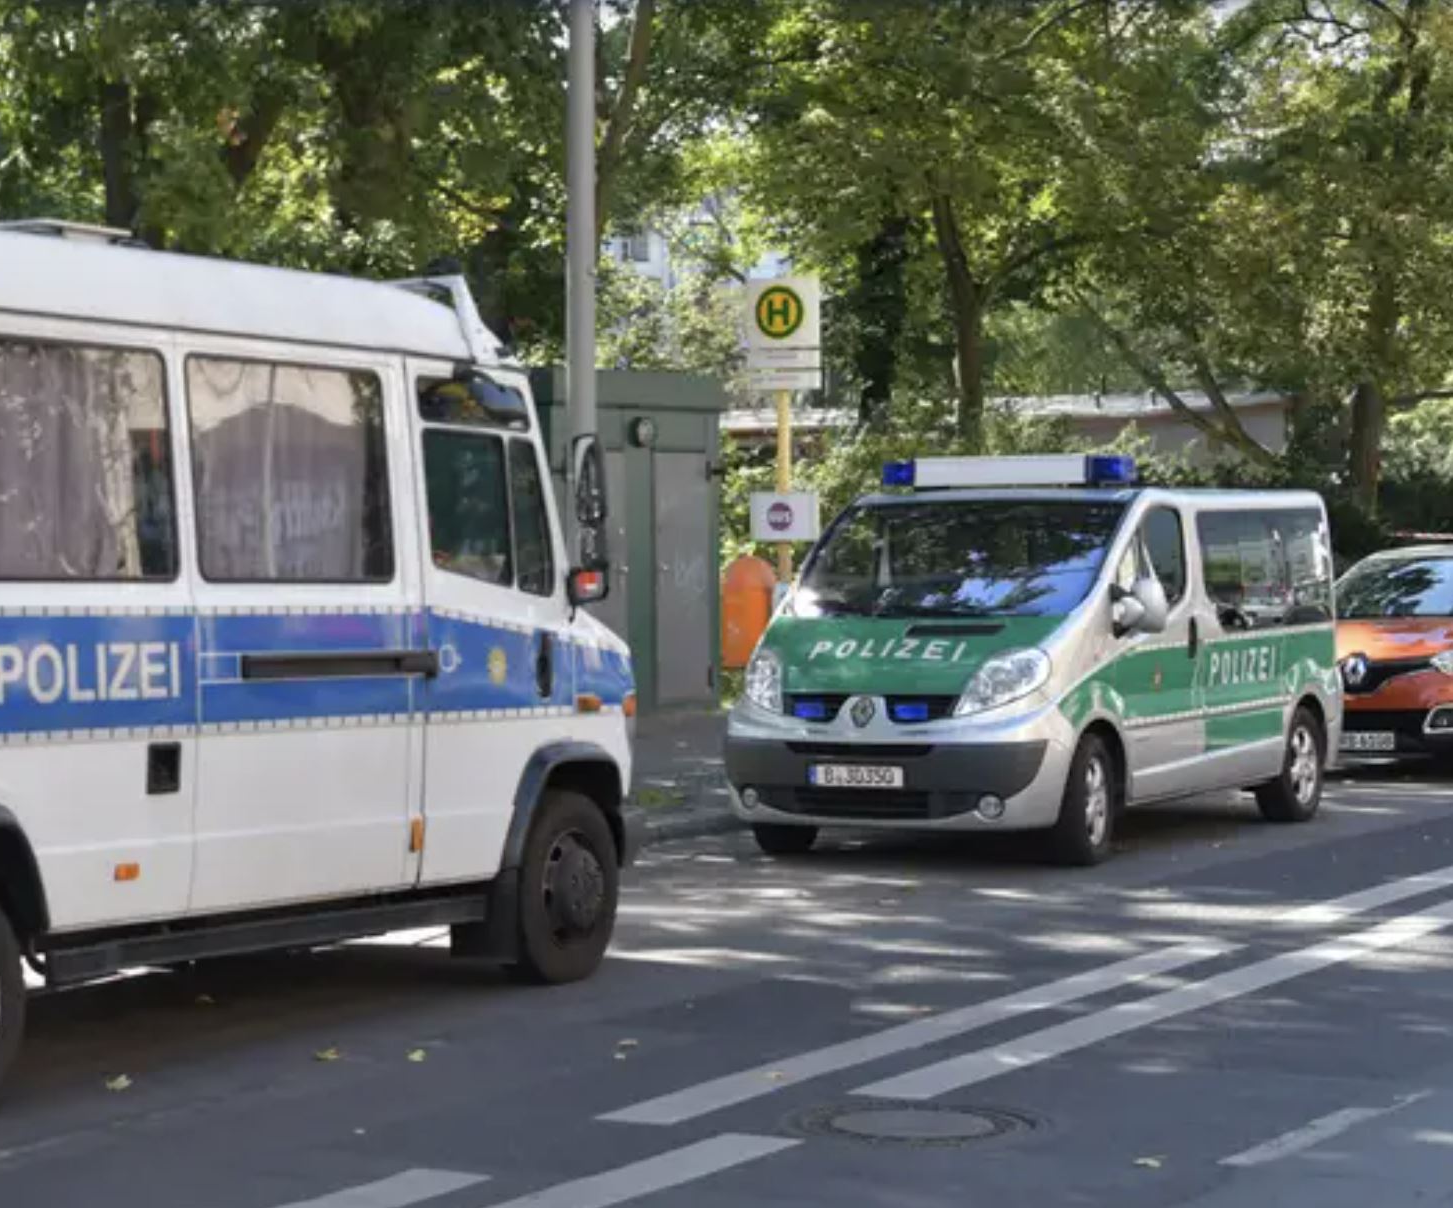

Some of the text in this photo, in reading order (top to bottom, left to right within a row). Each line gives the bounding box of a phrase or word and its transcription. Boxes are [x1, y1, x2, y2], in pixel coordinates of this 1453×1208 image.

[768, 297, 789, 326] H
[807, 638, 967, 662] POLIZEI
[1207, 644, 1277, 688] POLIZEI
